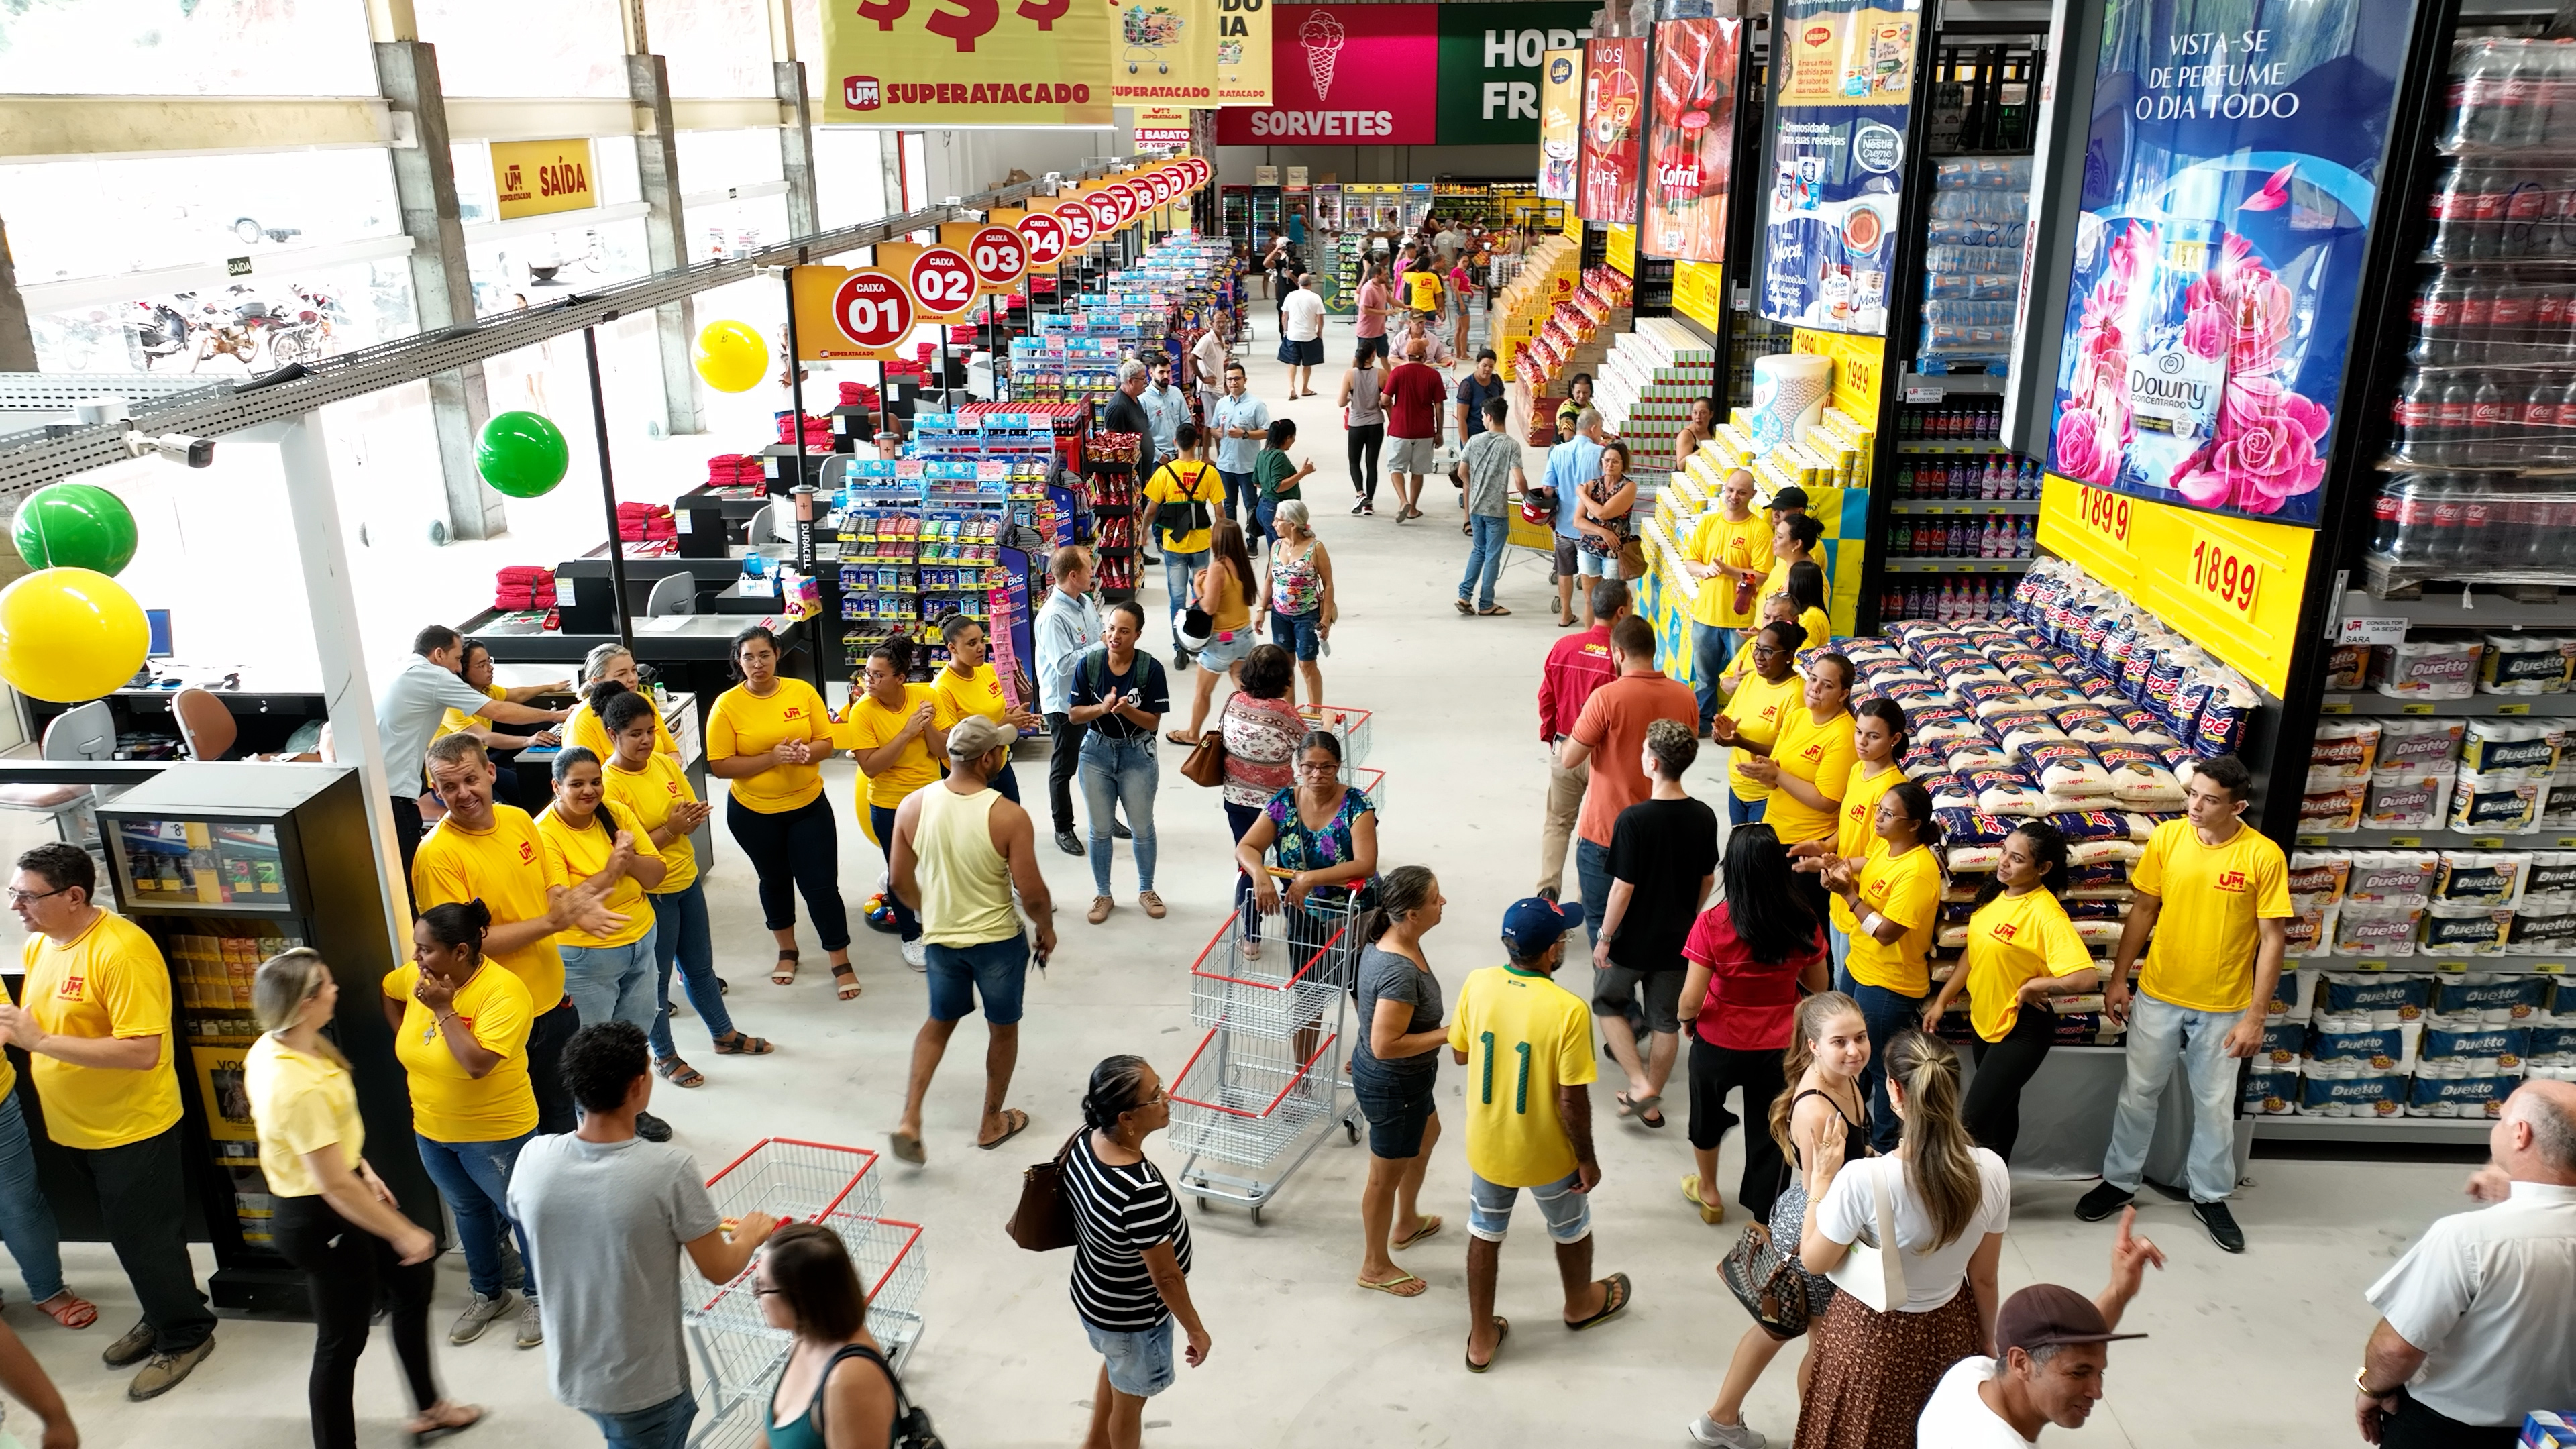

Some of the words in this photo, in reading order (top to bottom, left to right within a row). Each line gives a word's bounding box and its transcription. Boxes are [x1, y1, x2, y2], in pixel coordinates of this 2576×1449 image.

[2170, 29, 2271, 56] VISTA-SE
[1595, 46, 1621, 64] NÓS
[2149, 67, 2174, 89] DE
[2178, 62, 2288, 88] PERFUME
[887, 83, 1090, 104] SUPERATACADO
[2135, 96, 2152, 120] O
[2157, 95, 2196, 119] DIA
[2208, 92, 2300, 119] TODO
[1250, 111, 1393, 136] SORVETES
[1785, 123, 1830, 133] Cremosidade
[1135, 128, 1143, 139] É
[1144, 131, 1190, 140] BARATO
[1795, 136, 1810, 145] suas
[1811, 135, 1846, 146] receitas
[1862, 149, 1892, 158] Creme
[504, 165, 522, 192] UM
[539, 155, 588, 197] SAÍDA
[1589, 169, 1619, 187] CAFÉ
[1658, 164, 1699, 187] Cofril
[1029, 220, 1050, 228] CAIXA
[1027, 230, 1061, 254] 04
[975, 246, 1020, 272] 03
[1772, 241, 1803, 264] Moça
[228, 259, 252, 274] SAÍDA
[930, 258, 955, 266] CAIXA
[856, 283, 886, 293] CAIXA
[918, 270, 968, 301] 02
[848, 298, 900, 333] 01
[1796, 334, 1815, 356] 1999
[1847, 358, 1870, 394] 1999
[2131, 370, 2207, 410] Downy
[2131, 394, 2186, 409] CONCENTRADO
[2078, 484, 2129, 541] 1899
[801, 523, 812, 570] DURACELL
[1732, 537, 1746, 547] UM
[2194, 540, 2255, 612] 1899
[2410, 660, 2469, 676] Duetto
[2510, 655, 2565, 672] Duetto
[784, 708, 801, 718] UM
[2395, 739, 2450, 757] Duetto
[2495, 745, 2553, 763] Duetto
[2379, 792, 2428, 808] Duetto
[2478, 798, 2528, 814] Duetto
[519, 841, 533, 860] UM
[1871, 879, 1886, 894] UM
[2219, 871, 2245, 888] UM
[2365, 873, 2421, 888] Duetto
[2456, 876, 2508, 888] Duetto
[1994, 923, 2017, 941] UM
[2355, 923, 2410, 936] Duetto
[2442, 922, 2498, 936] Duetto
[61, 976, 84, 996] UM
[2355, 989, 2406, 1003] Duetto
[2466, 989, 2519, 1002] Duetto
[2337, 1037, 2383, 1049] Duetto
[2454, 1036, 2507, 1051] Duetto
[1480, 1030, 1532, 1115] 11
[2331, 1084, 2383, 1096] Duetto
[2440, 1083, 2493, 1096] Duetto
